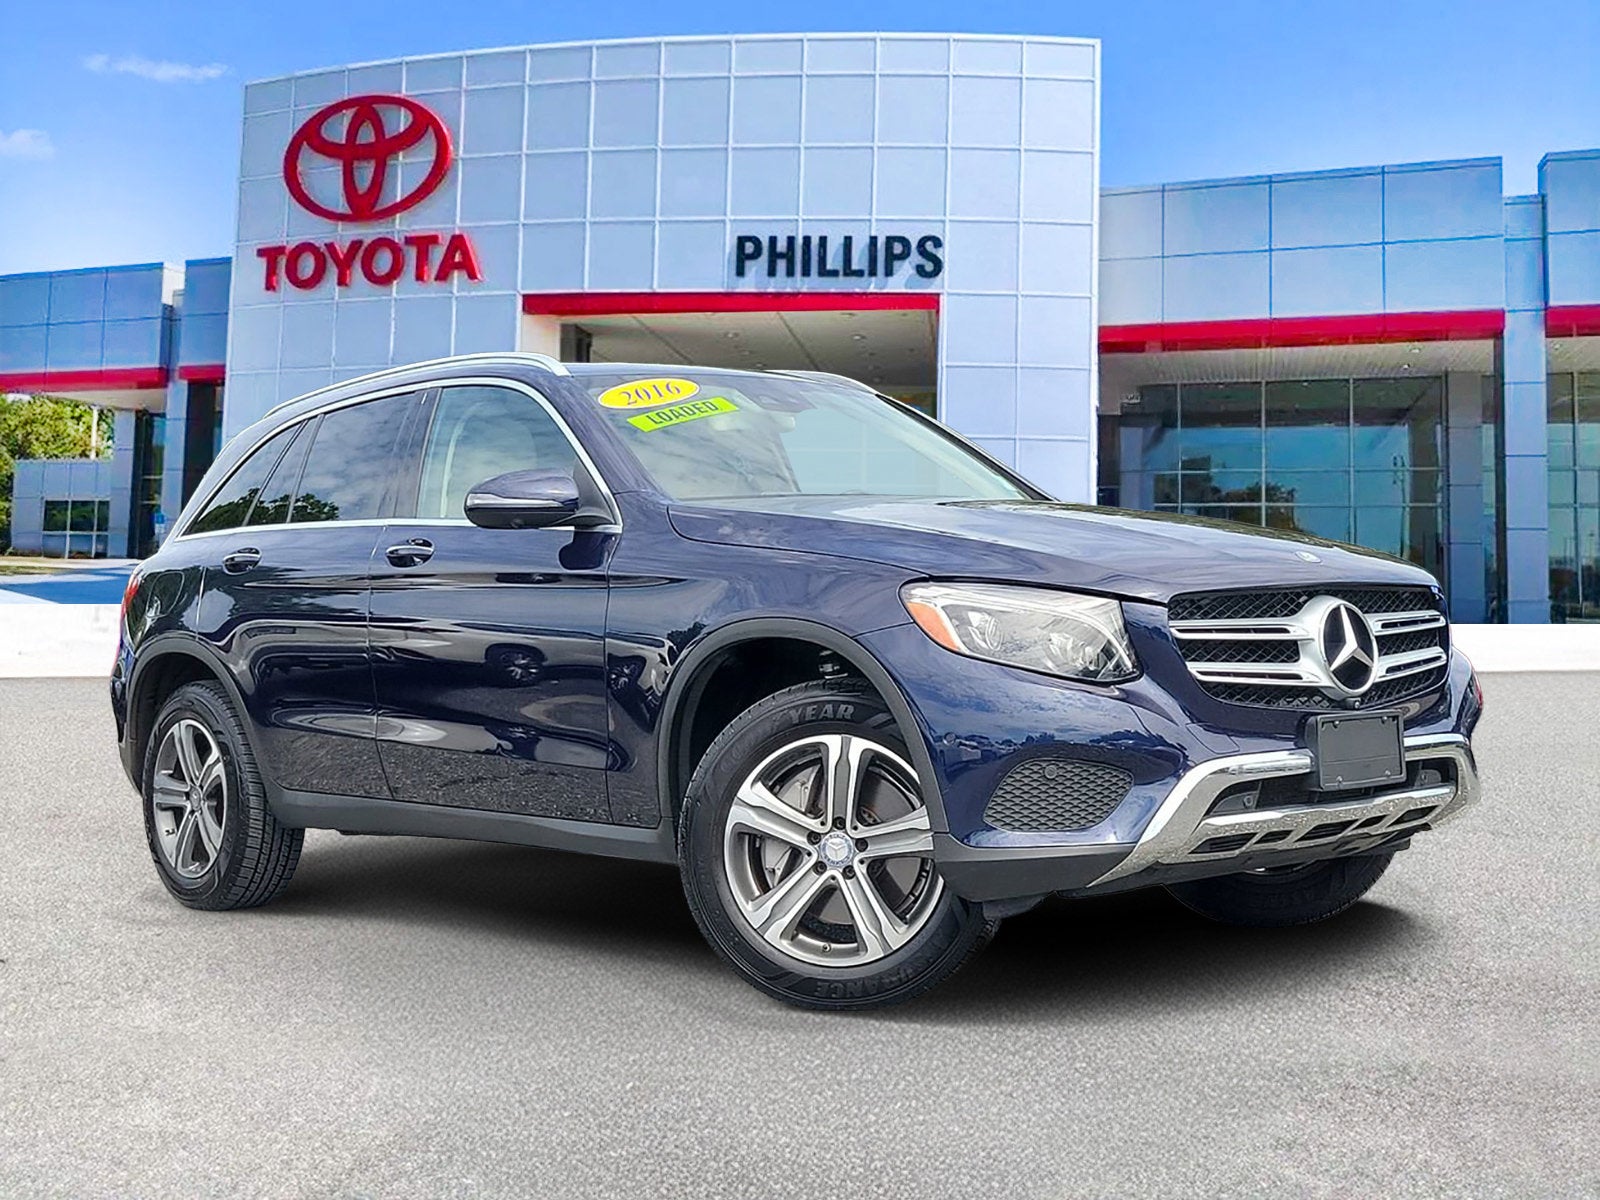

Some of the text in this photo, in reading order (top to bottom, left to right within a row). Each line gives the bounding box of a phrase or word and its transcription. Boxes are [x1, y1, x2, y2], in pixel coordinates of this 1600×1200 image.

[256, 233, 484, 292] TOYOTA
[735, 235, 944, 278] PHILLIPS
[620, 381, 681, 405] 2016
[647, 400, 719, 425] LOADED
